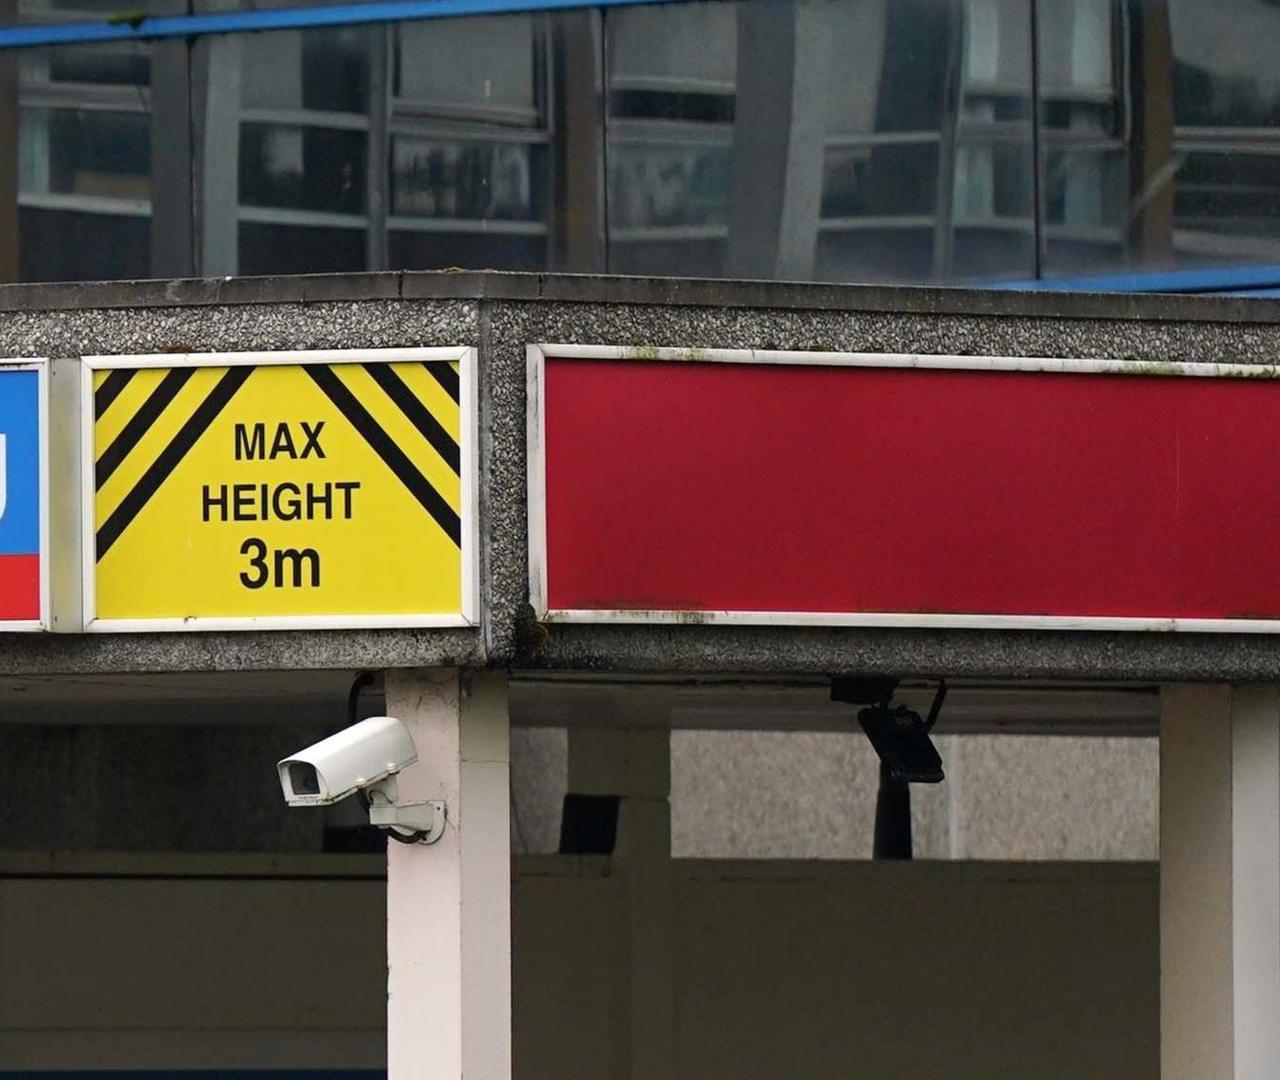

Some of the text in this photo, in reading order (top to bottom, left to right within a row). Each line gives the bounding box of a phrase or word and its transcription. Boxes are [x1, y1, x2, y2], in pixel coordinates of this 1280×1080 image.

[234, 421, 326, 460] MAX
[202, 481, 361, 522] HEIGHT
[239, 538, 321, 589] 3m
